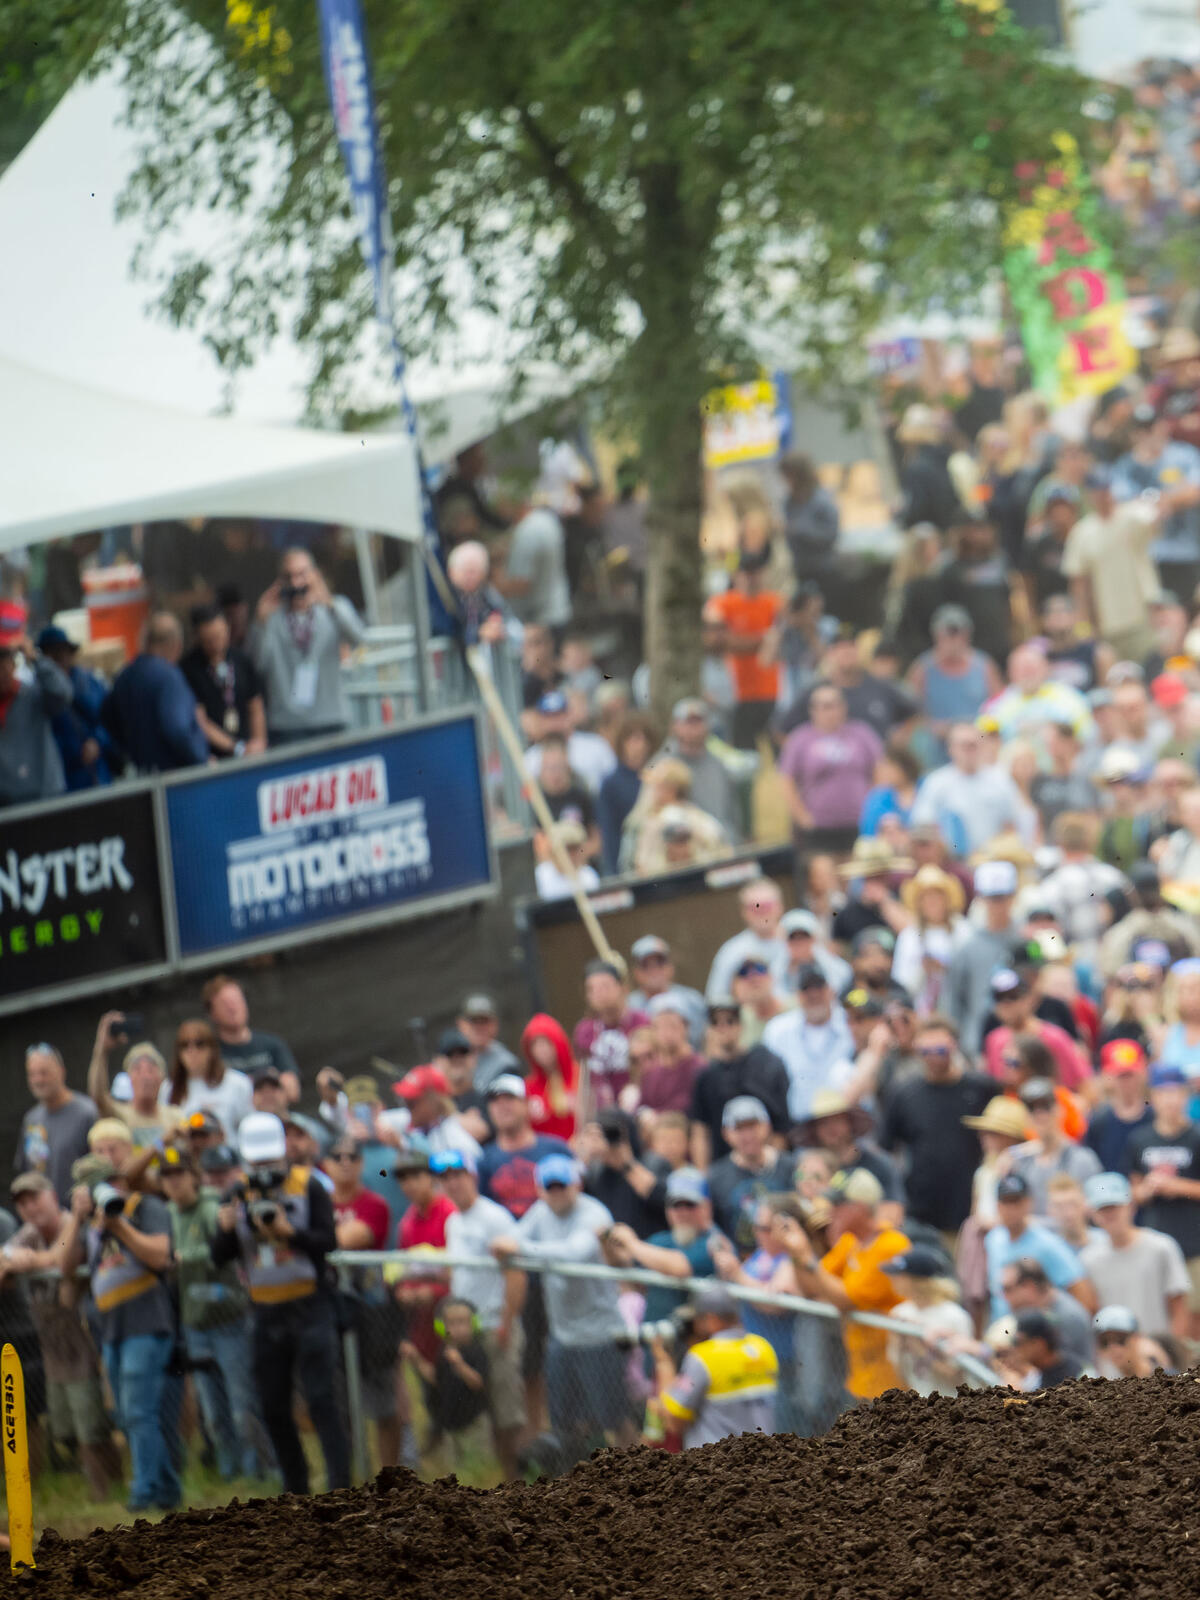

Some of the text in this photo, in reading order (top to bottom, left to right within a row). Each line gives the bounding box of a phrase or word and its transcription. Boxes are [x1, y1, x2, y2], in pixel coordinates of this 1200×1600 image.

[268, 763, 380, 826] LUCAS OIL
[227, 816, 431, 910] MOTOCROSS
[0, 907, 104, 957] ERGY
